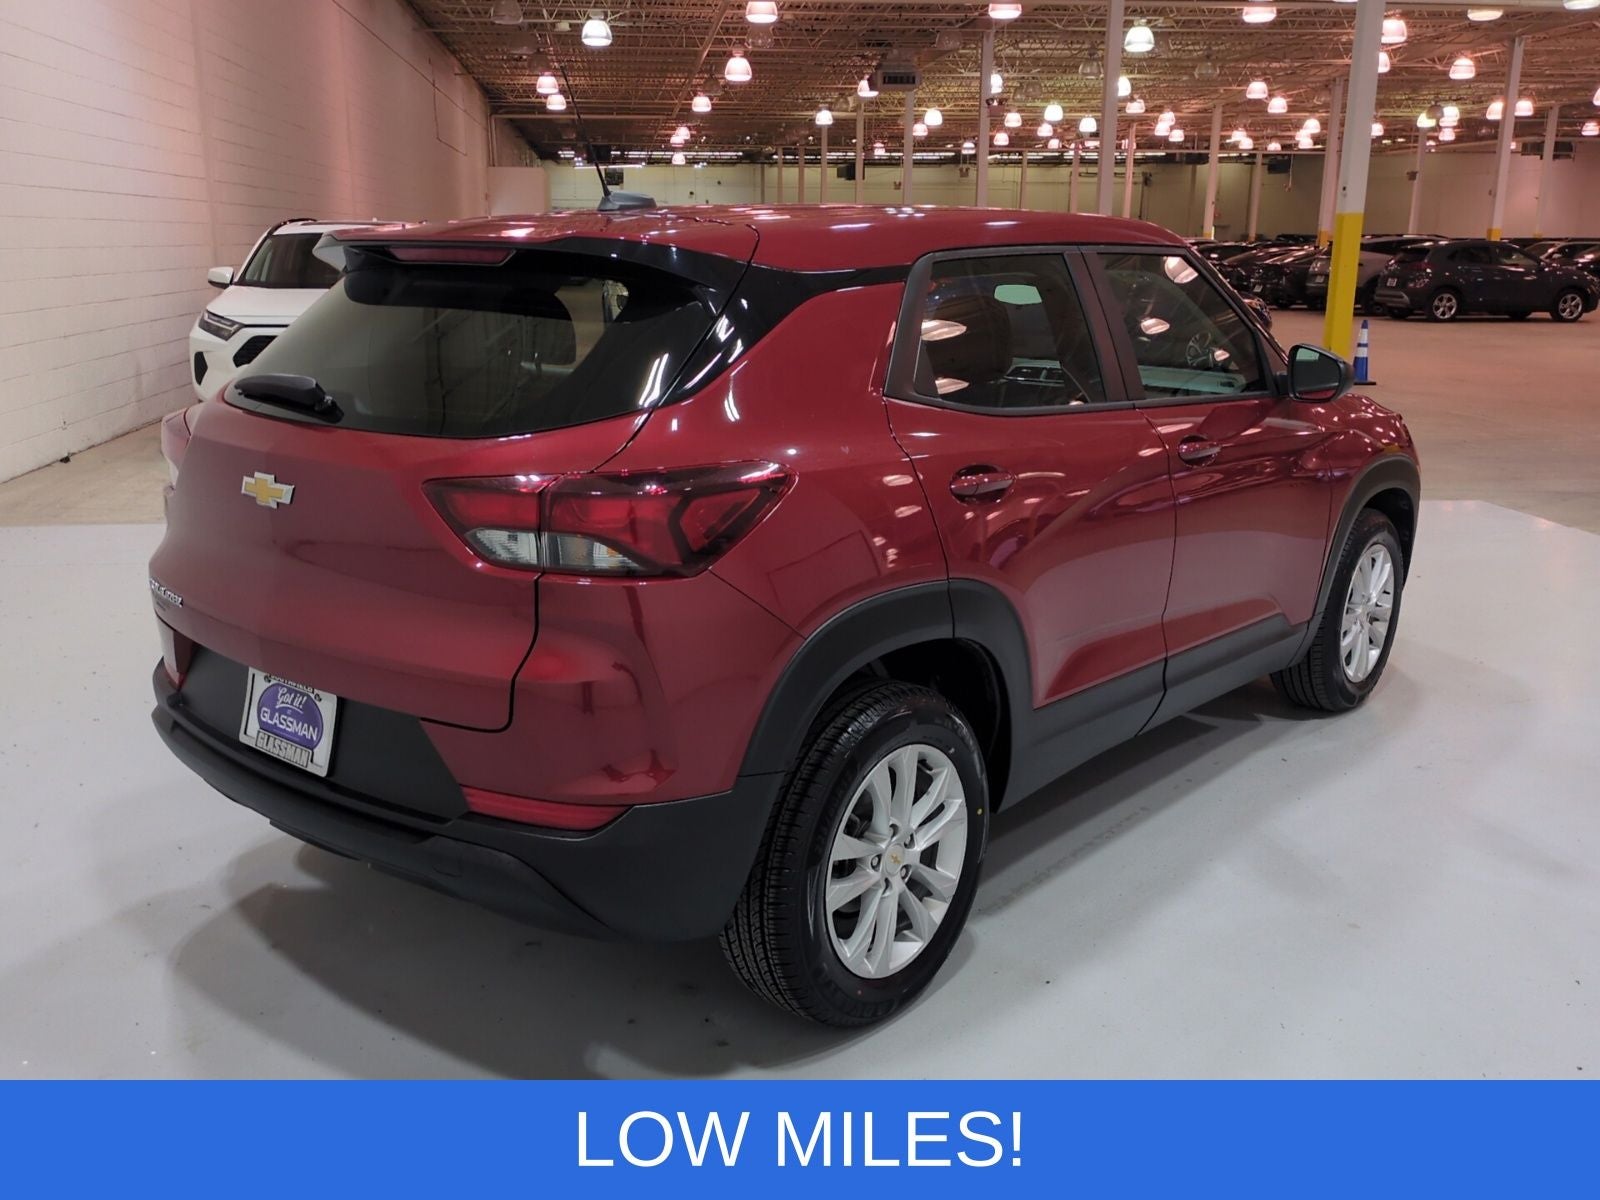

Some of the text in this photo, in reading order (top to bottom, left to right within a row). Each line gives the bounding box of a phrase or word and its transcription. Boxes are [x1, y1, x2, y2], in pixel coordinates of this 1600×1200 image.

[276, 687, 294, 708] Got
[260, 707, 318, 741] GLASSMAN
[257, 732, 309, 767] GLASSMAN
